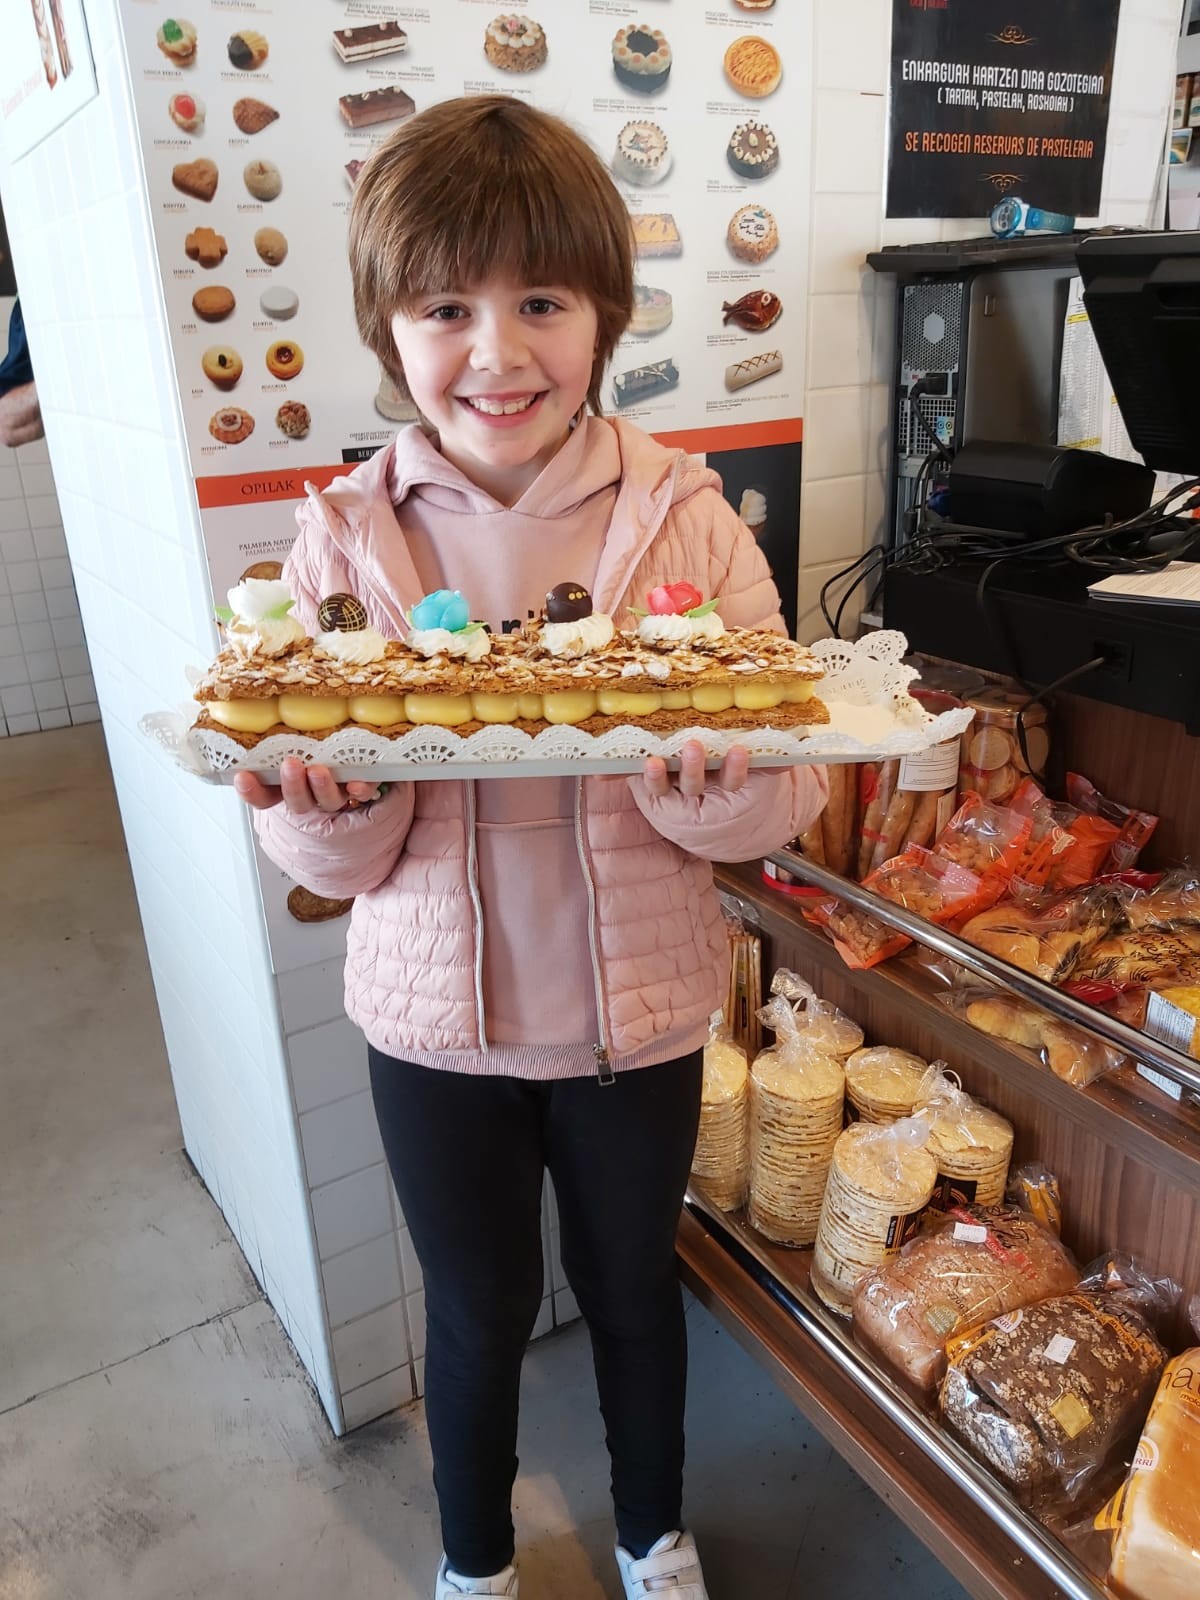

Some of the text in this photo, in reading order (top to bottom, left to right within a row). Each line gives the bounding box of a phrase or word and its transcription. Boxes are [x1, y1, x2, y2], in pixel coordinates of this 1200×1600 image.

[902, 60, 1104, 95] ENKARGUAK HARTZEN DIRA GOZOTEGIAN
[905, 131, 1094, 159] SE RECOGEN RESERVAS DE PASTELERIA
[240, 478, 295, 496] OPILAK
[238, 540, 273, 551] PALMERA
[245, 546, 275, 557] PALMERA
